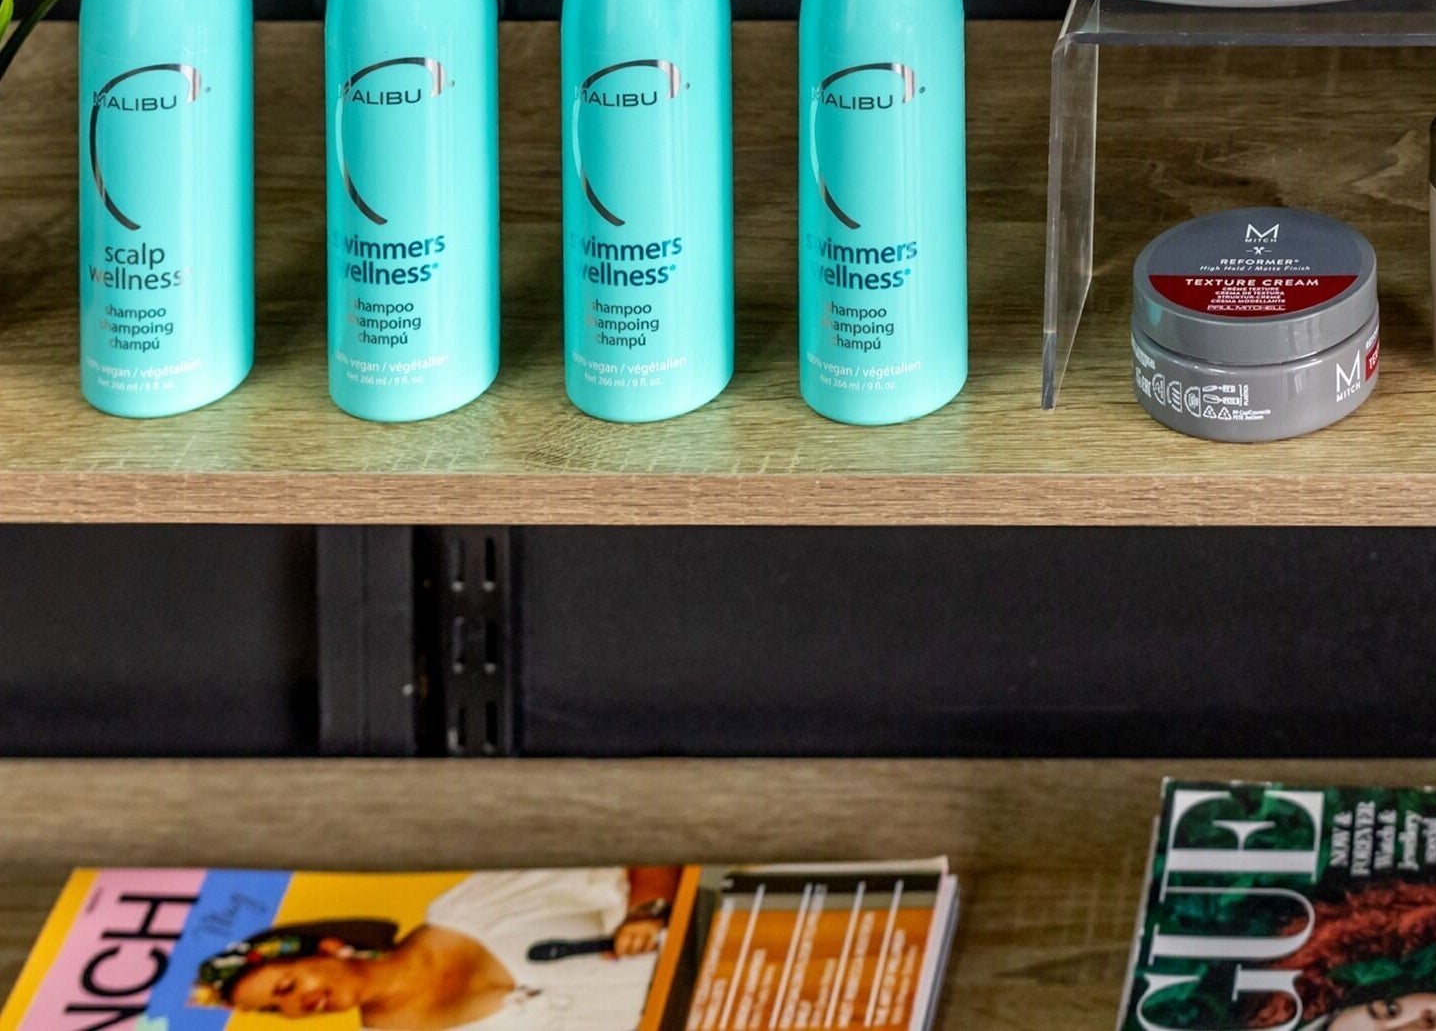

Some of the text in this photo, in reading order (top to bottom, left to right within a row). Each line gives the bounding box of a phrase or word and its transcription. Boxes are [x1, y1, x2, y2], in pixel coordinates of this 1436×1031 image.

[93, 91, 178, 112] MALIBU
[104, 242, 165, 269] scalp
[1199, 265, 1221, 273] High
[1185, 278, 1320, 286] TEXTURE CREAM
[1336, 382, 1361, 403] MITCH
